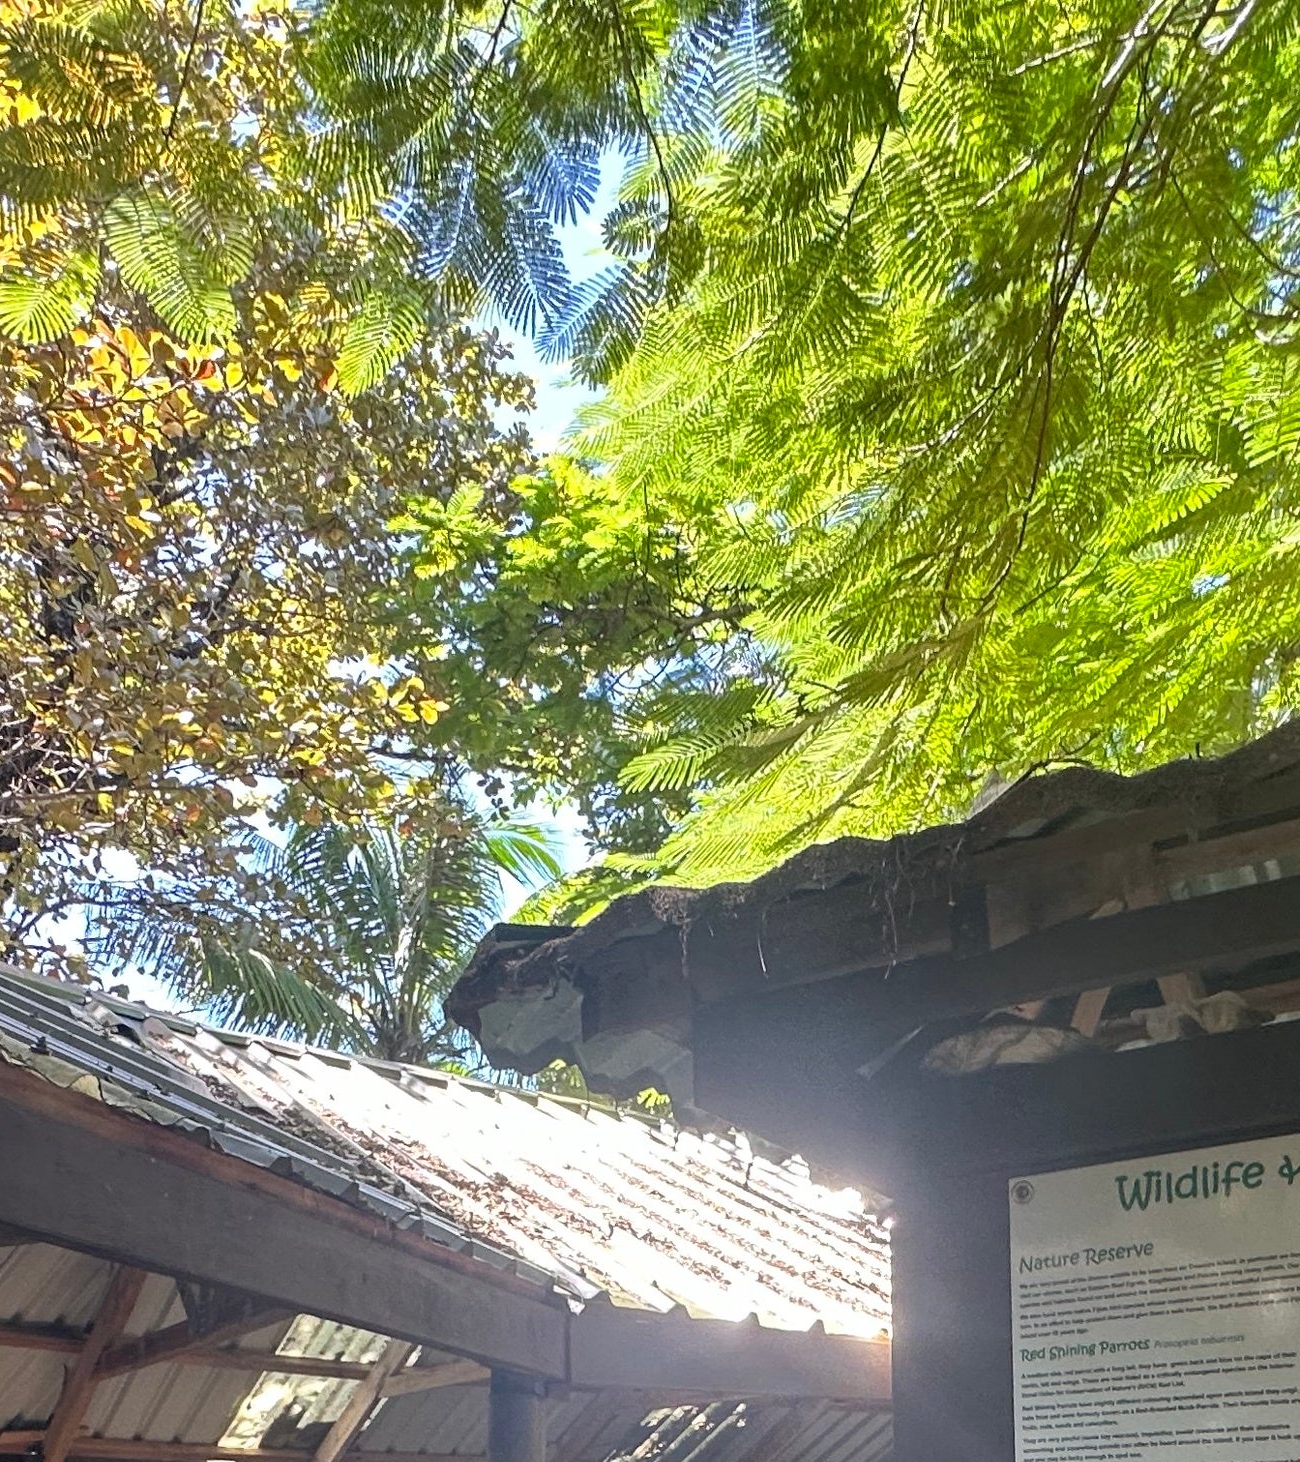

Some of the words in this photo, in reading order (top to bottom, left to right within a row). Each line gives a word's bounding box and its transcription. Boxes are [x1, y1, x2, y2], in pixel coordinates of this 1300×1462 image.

[1115, 1160, 1265, 1211] Wildlife
[1020, 1251, 1079, 1273] Nature
[1084, 1242, 1154, 1266] Reserve
[1021, 1347, 1046, 1362] Red
[1050, 1341, 1096, 1360] Shining
[1099, 1339, 1150, 1354] Parrots
